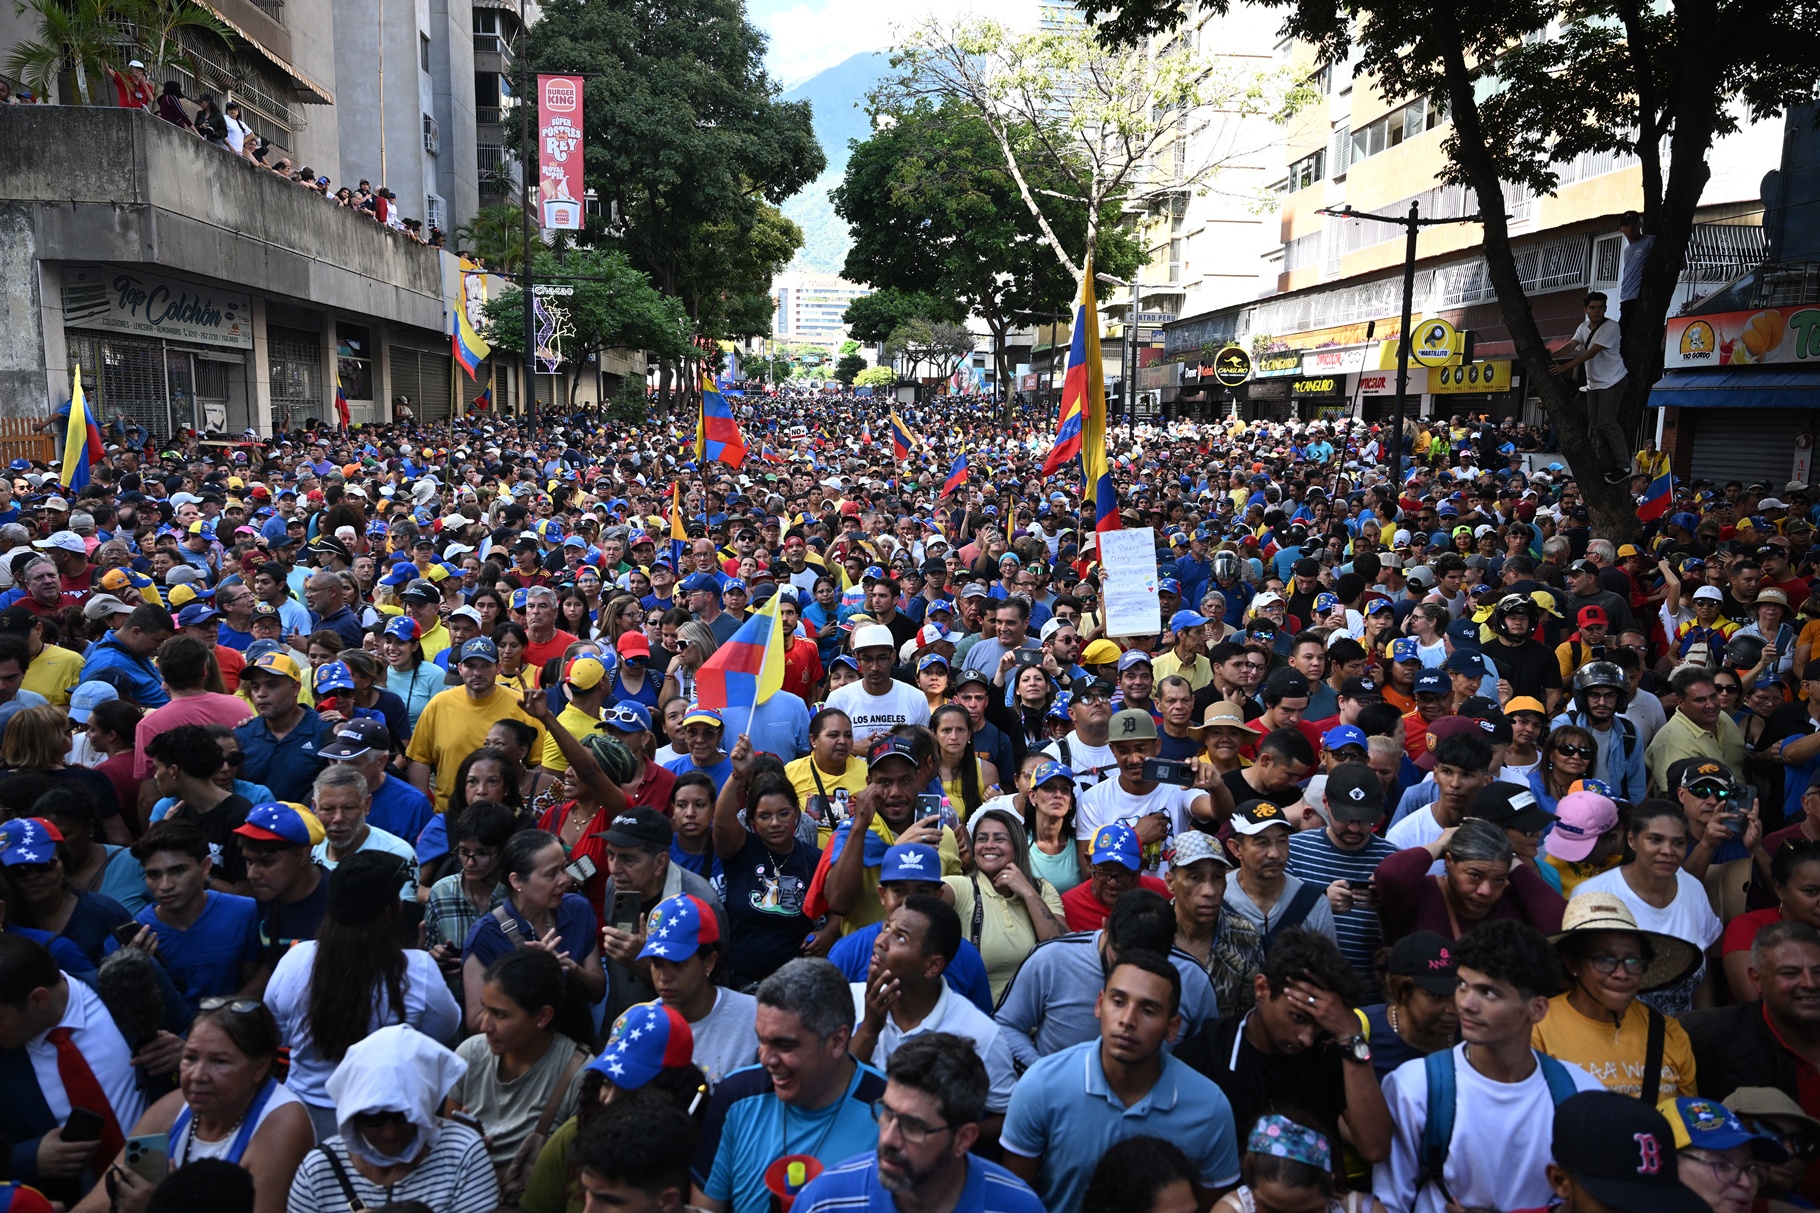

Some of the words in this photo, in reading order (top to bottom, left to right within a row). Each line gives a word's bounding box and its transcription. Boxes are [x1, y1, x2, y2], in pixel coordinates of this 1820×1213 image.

[547, 88, 575, 96] BURGER
[547, 96, 575, 105] KING
[542, 126, 581, 139] POSTRES
[546, 137, 578, 162] REY
[542, 166, 565, 177] ROYAL
[551, 172, 565, 180] PIE
[113, 275, 148, 317] Top
[145, 284, 222, 328] Colchón
[1129, 314, 1156, 322] CNTRO
[1158, 314, 1176, 322] PERU
[1682, 352, 1691, 360] TIO
[1692, 352, 1711, 360] GORDO
[1266, 357, 1298, 370] CANGURO
[1217, 367, 1248, 375] CANGURO
[1300, 379, 1335, 393] CANGURO
[853, 716, 869, 724] LOS
[870, 714, 906, 723] ANGELES
[1122, 716, 1136, 735] D
[1633, 1132, 1660, 1175] B
